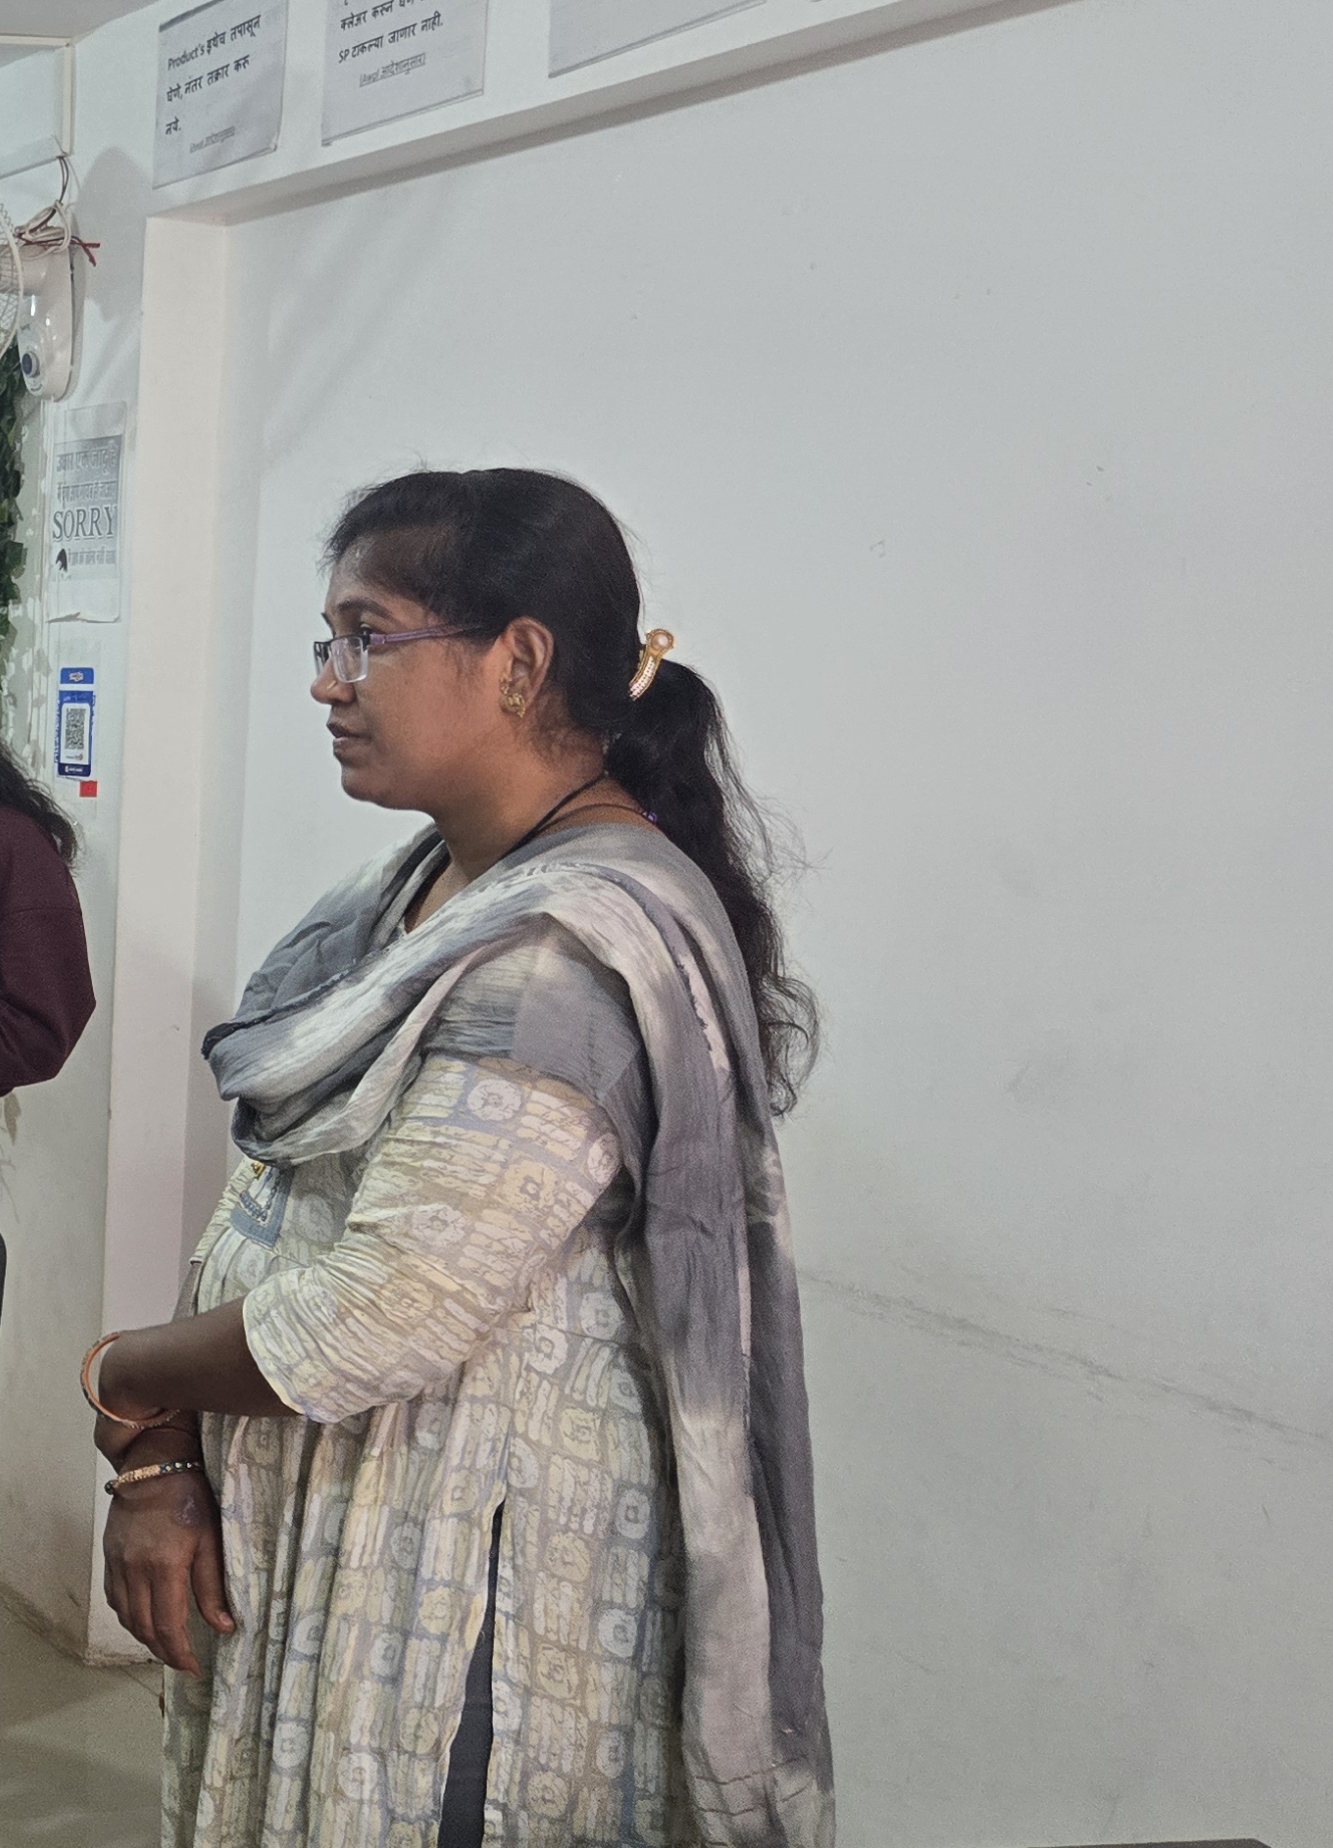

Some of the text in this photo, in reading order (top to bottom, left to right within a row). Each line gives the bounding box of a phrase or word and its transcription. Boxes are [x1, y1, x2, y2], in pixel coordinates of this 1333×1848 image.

[167, 43, 205, 71] Product's
[338, 49, 350, 63] SP
[388, 23, 418, 44] जाणार
[53, 505, 118, 541] SORRY
